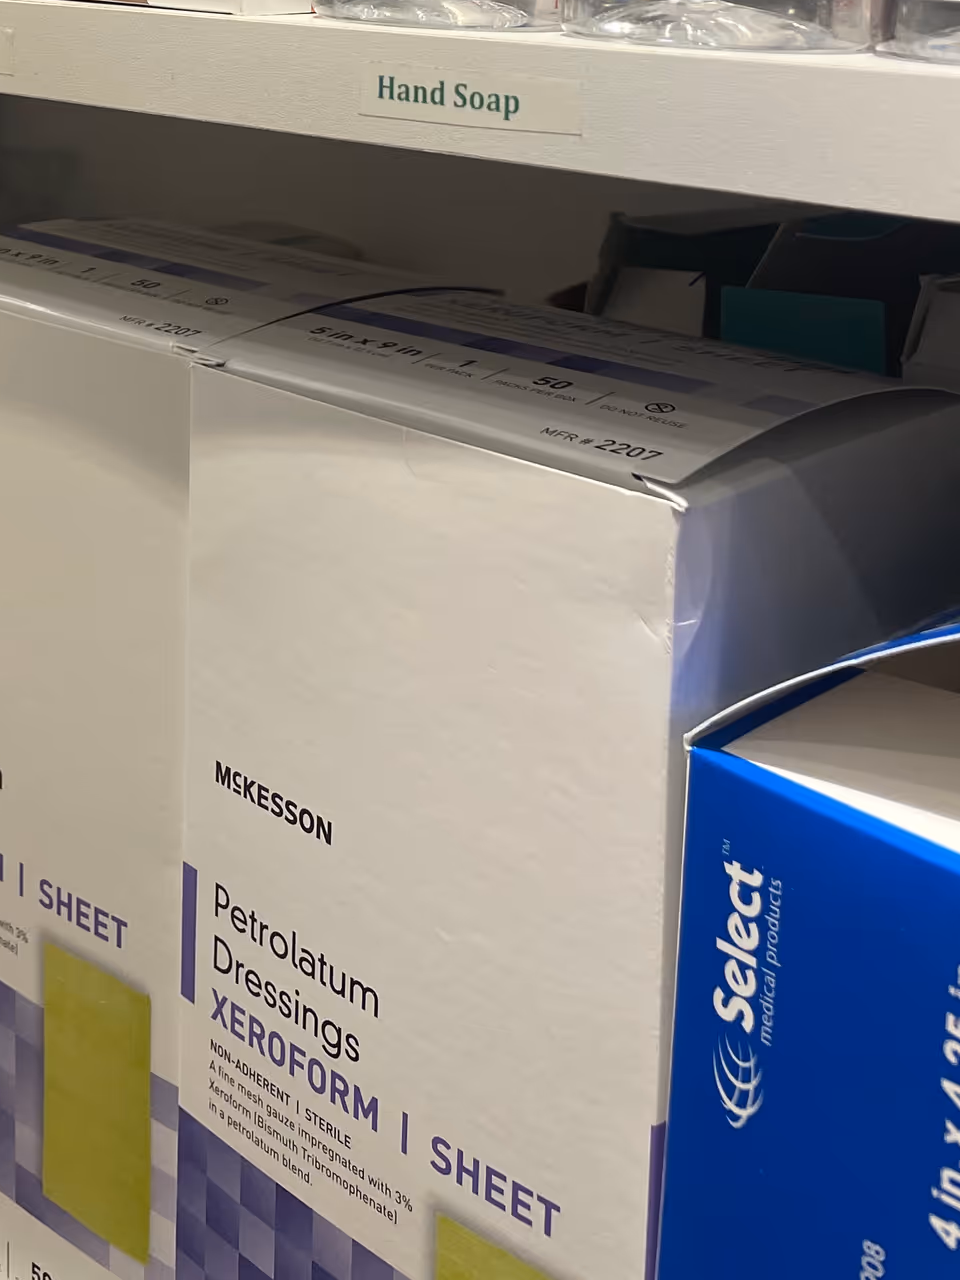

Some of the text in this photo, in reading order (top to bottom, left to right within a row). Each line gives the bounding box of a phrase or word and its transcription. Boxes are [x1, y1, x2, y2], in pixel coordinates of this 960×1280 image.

[376, 75, 521, 121] Hand Soap
[131, 279, 161, 290] 50
[459, 359, 479, 369] 1
[532, 376, 574, 391] 50
[540, 426, 664, 463] MFR # 2207
[39, 878, 129, 949] SHEET
[214, 882, 380, 1019] Petrolatum
[712, 858, 764, 1034] Select
[760, 877, 783, 1047] medical products
[213, 935, 361, 1063] Dressings
[208, 1098, 313, 1187] in a petrolatum blend.
[209, 1059, 413, 1213] A fine mesh gauze impregnated with 3%
[210, 1038, 352, 1150] NON-ADHERENT STERILE
[210, 987, 562, 1238] XEROFORM SHEET
[209, 1077, 398, 1225] Xeroform (Bismuth Tribromophenate)
